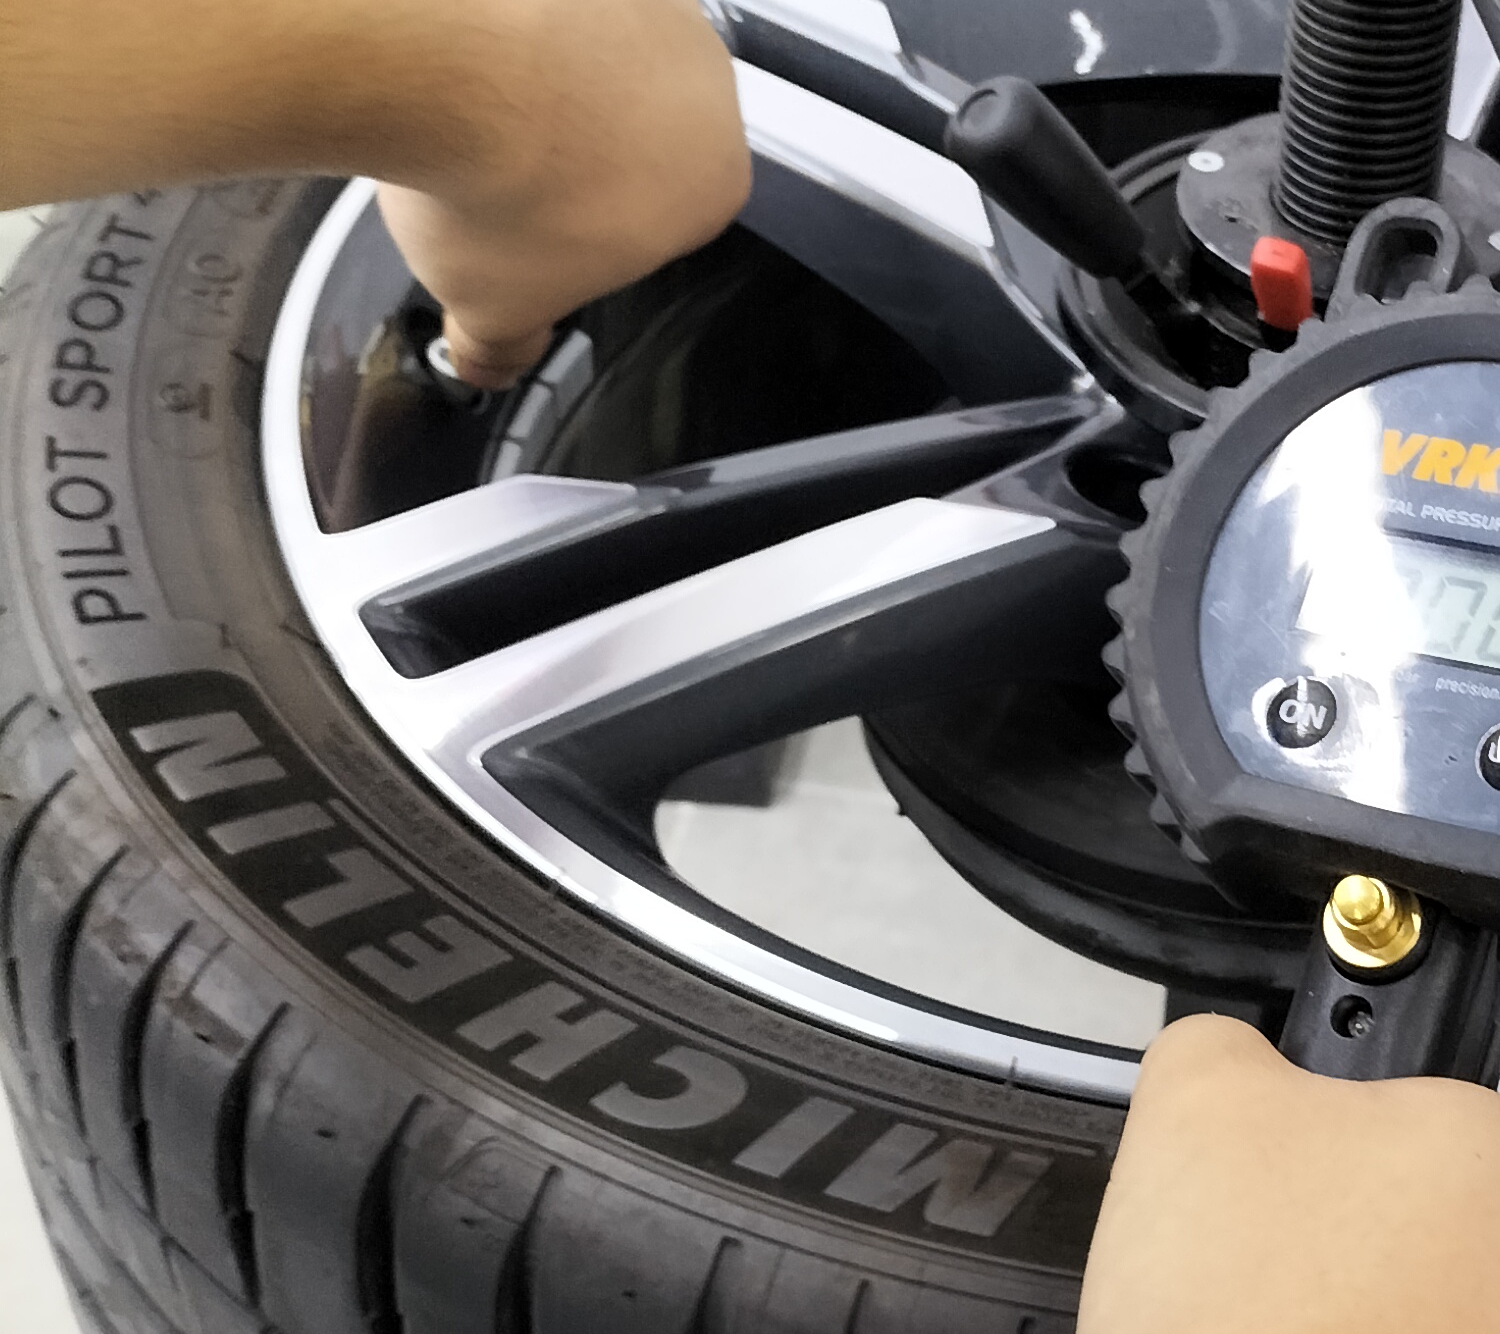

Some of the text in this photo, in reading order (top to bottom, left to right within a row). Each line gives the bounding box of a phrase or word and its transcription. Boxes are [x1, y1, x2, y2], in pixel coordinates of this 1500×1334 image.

[46, 213, 155, 627] PILOT SPORT
[1278, 698, 1329, 731] ON
[130, 708, 1054, 1238] MICHELIN
